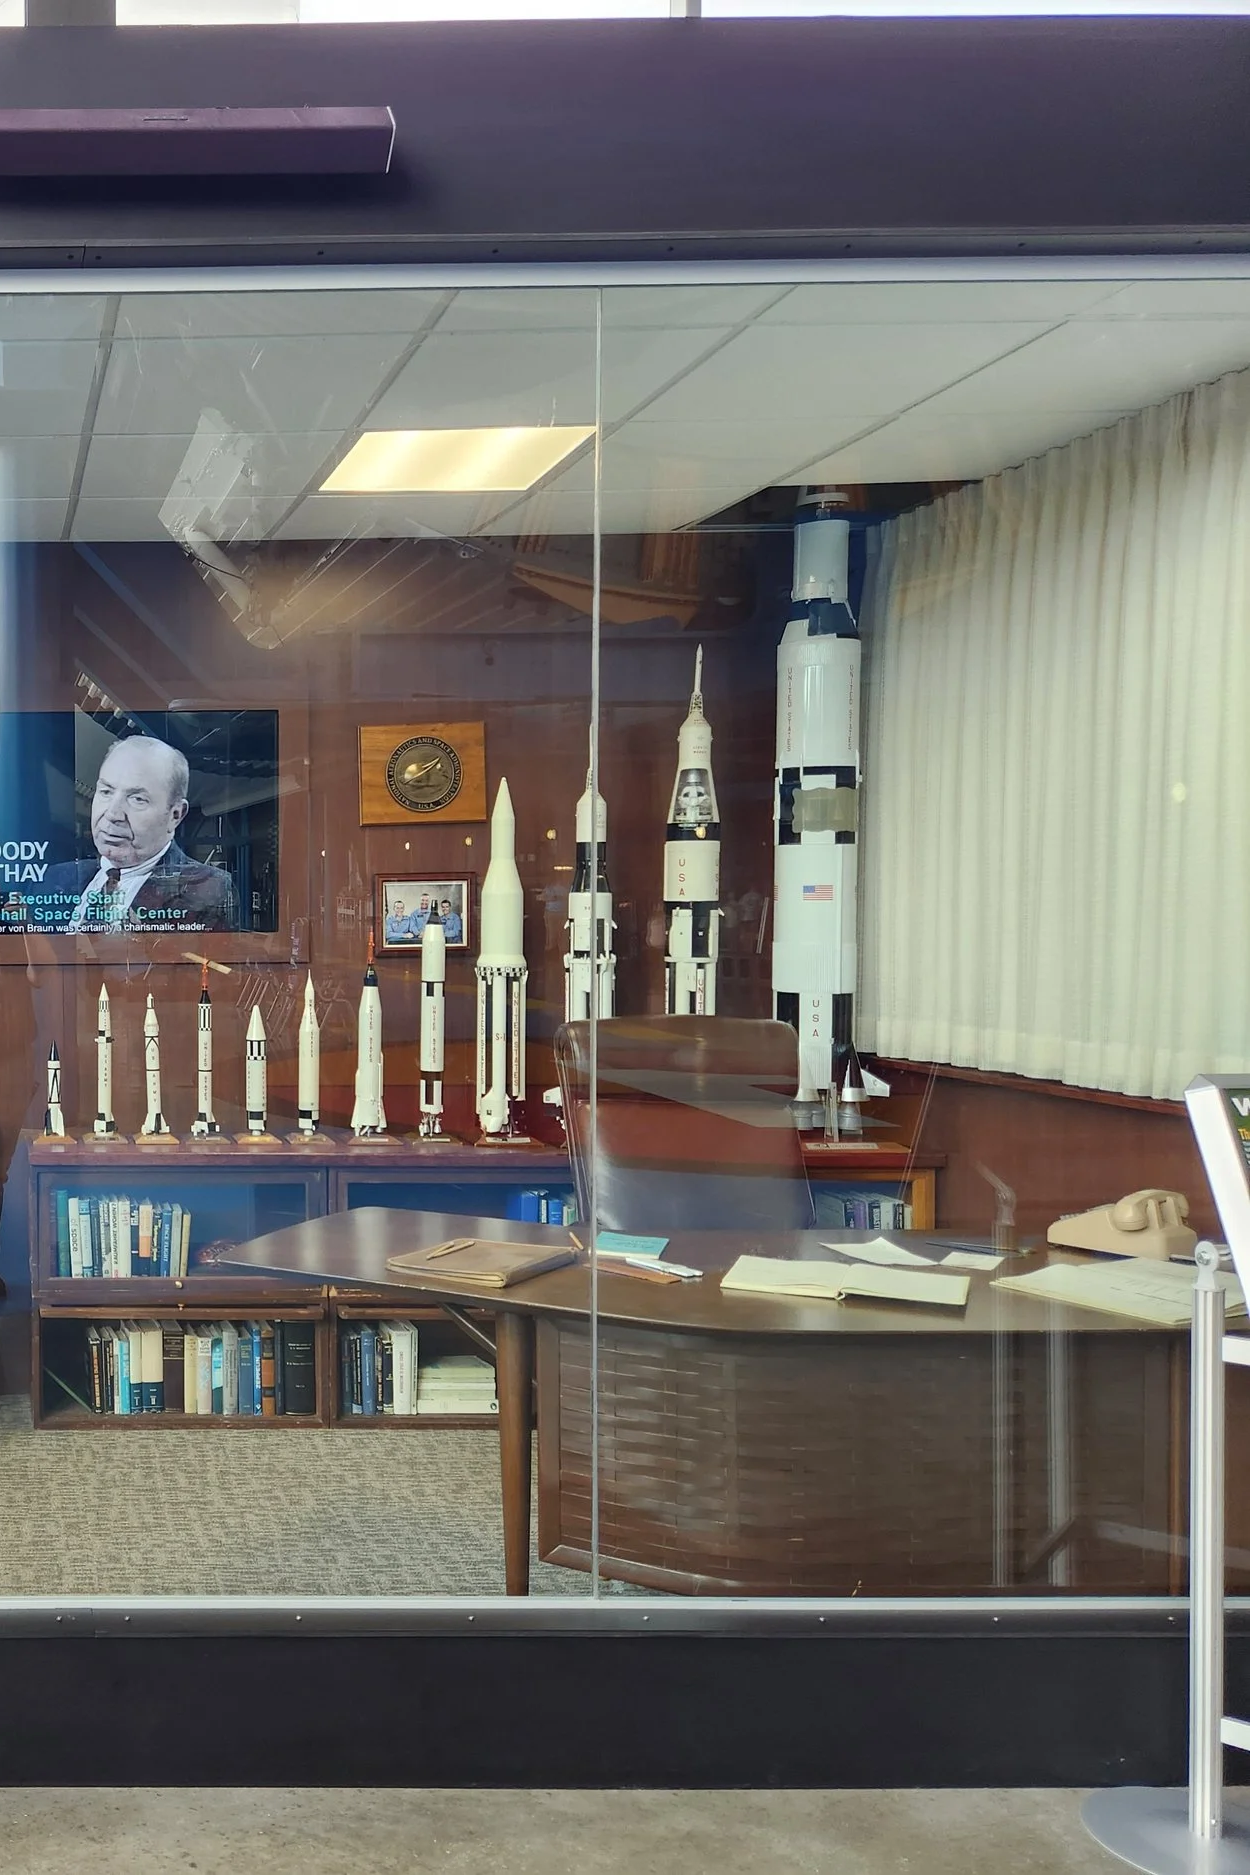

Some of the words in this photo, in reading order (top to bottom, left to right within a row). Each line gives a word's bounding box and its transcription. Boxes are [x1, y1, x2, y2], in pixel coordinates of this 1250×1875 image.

[678, 858, 686, 896] USA
[8, 891, 81, 906] Executive
[87, 891, 126, 905] Staff
[34, 908, 80, 923] Space
[87, 907, 129, 923] Flight
[138, 906, 188, 919] Center
[8, 925, 25, 933] von
[27, 923, 54, 933] Braun
[76, 923, 113, 934] certainly
[123, 923, 175, 932] charismatic
[812, 999, 820, 1037] USA
[70, 1228, 79, 1252] space
